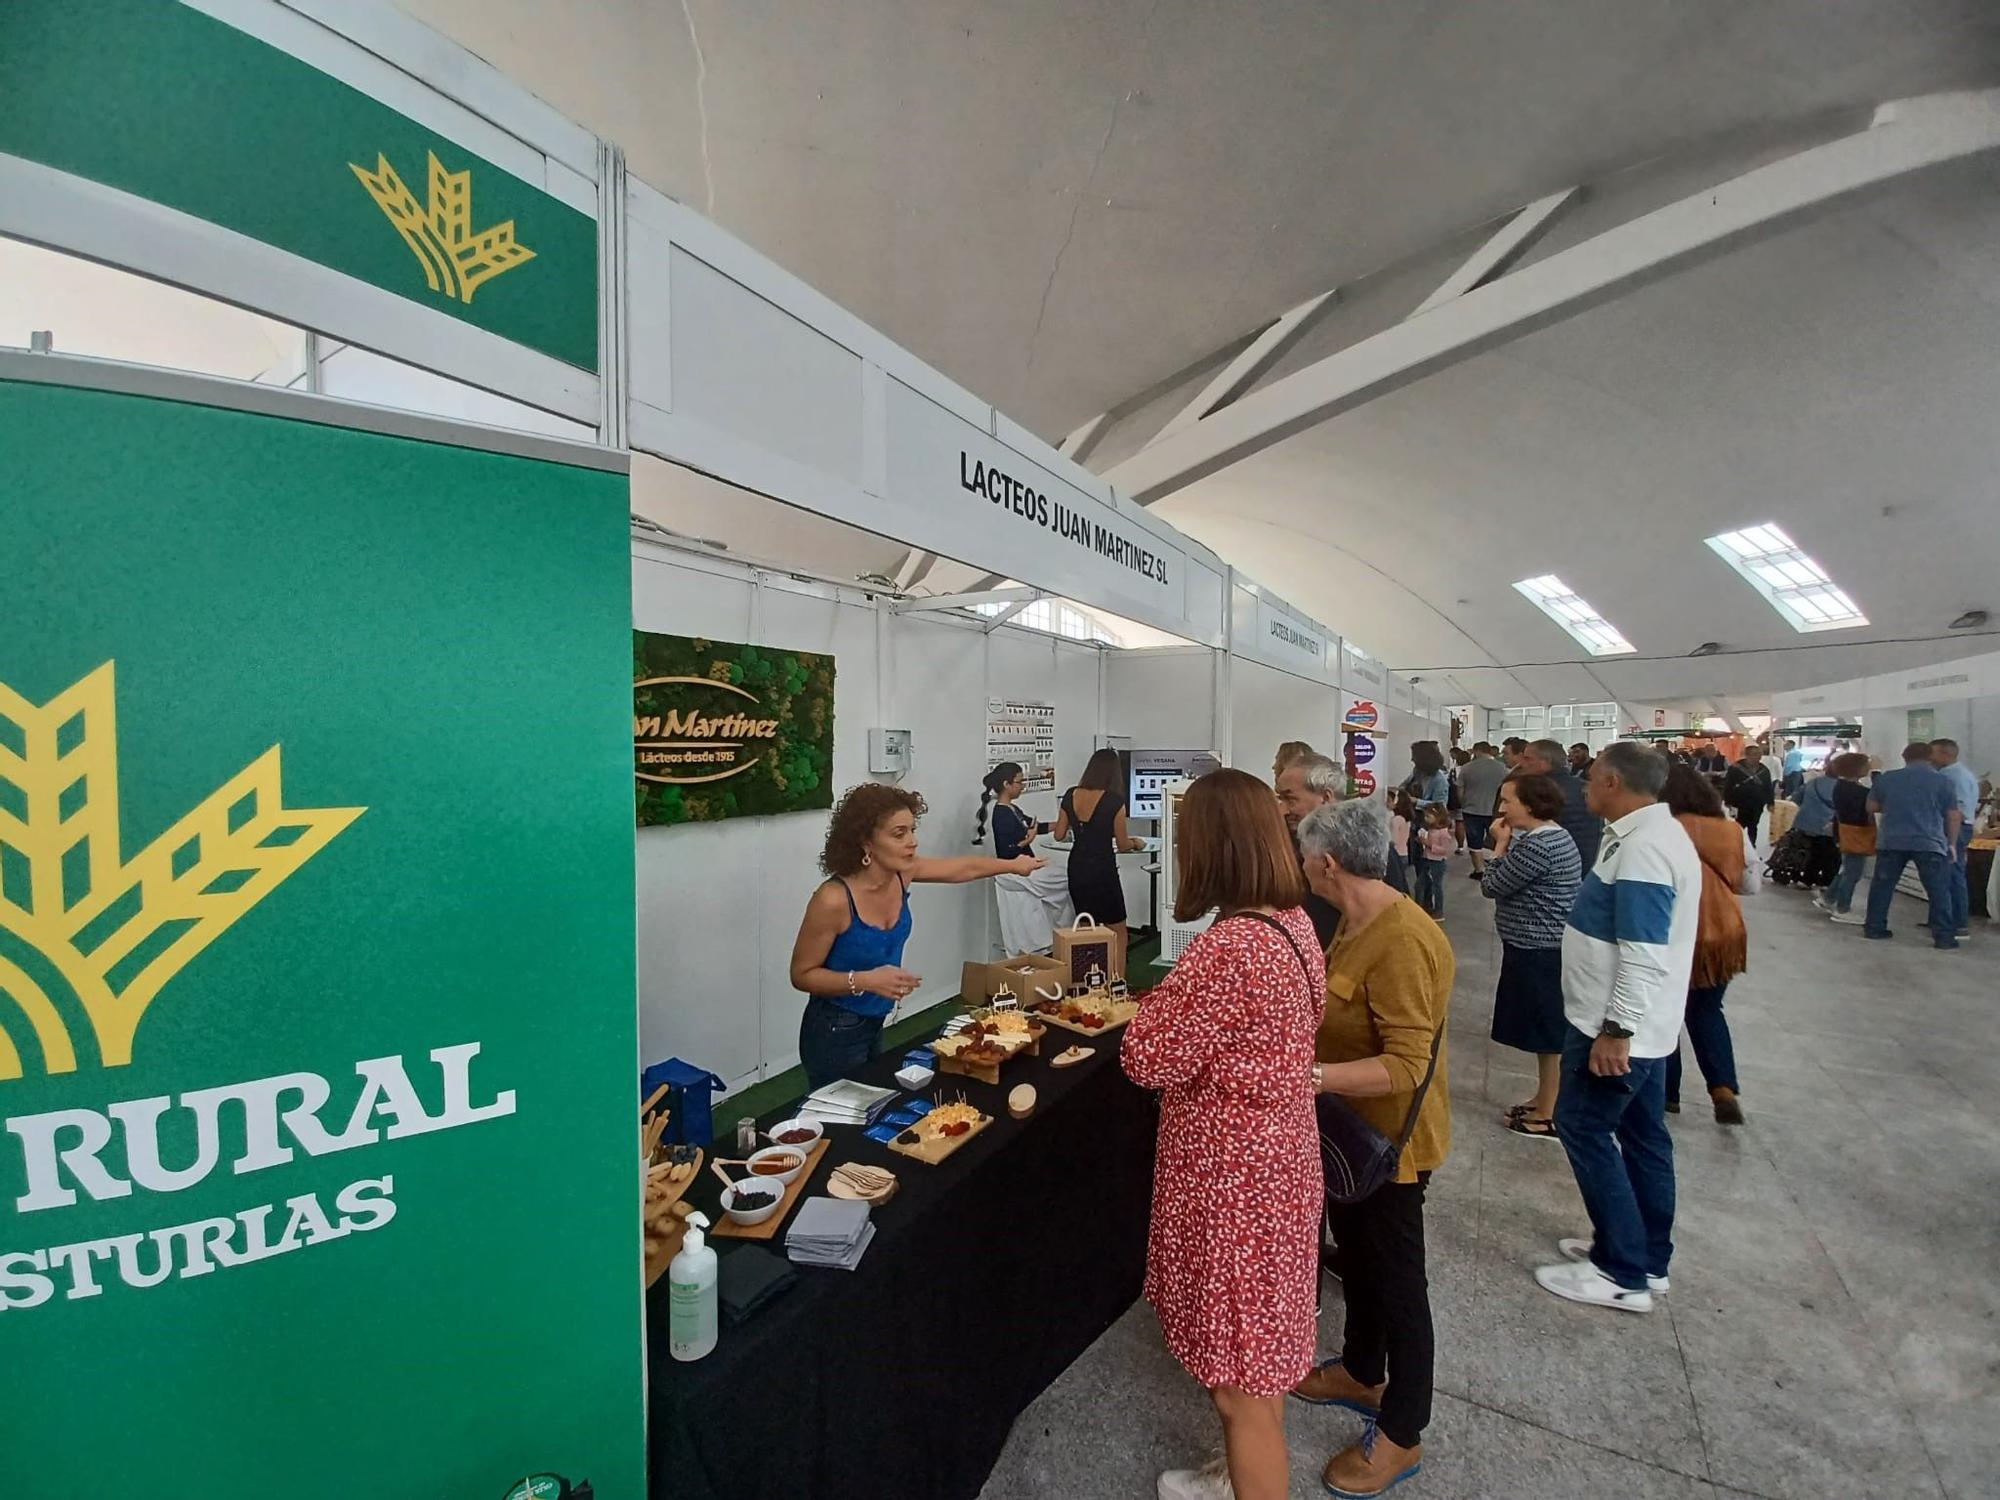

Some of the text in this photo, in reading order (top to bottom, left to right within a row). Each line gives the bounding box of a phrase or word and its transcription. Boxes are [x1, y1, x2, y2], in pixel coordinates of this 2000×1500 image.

[961, 450, 1169, 585] LACTEOS JUAN MARTINEZ SL
[683, 750, 714, 763] desde
[6, 1041, 517, 1214] RURAL
[0, 1174, 398, 1312] STURIAS
